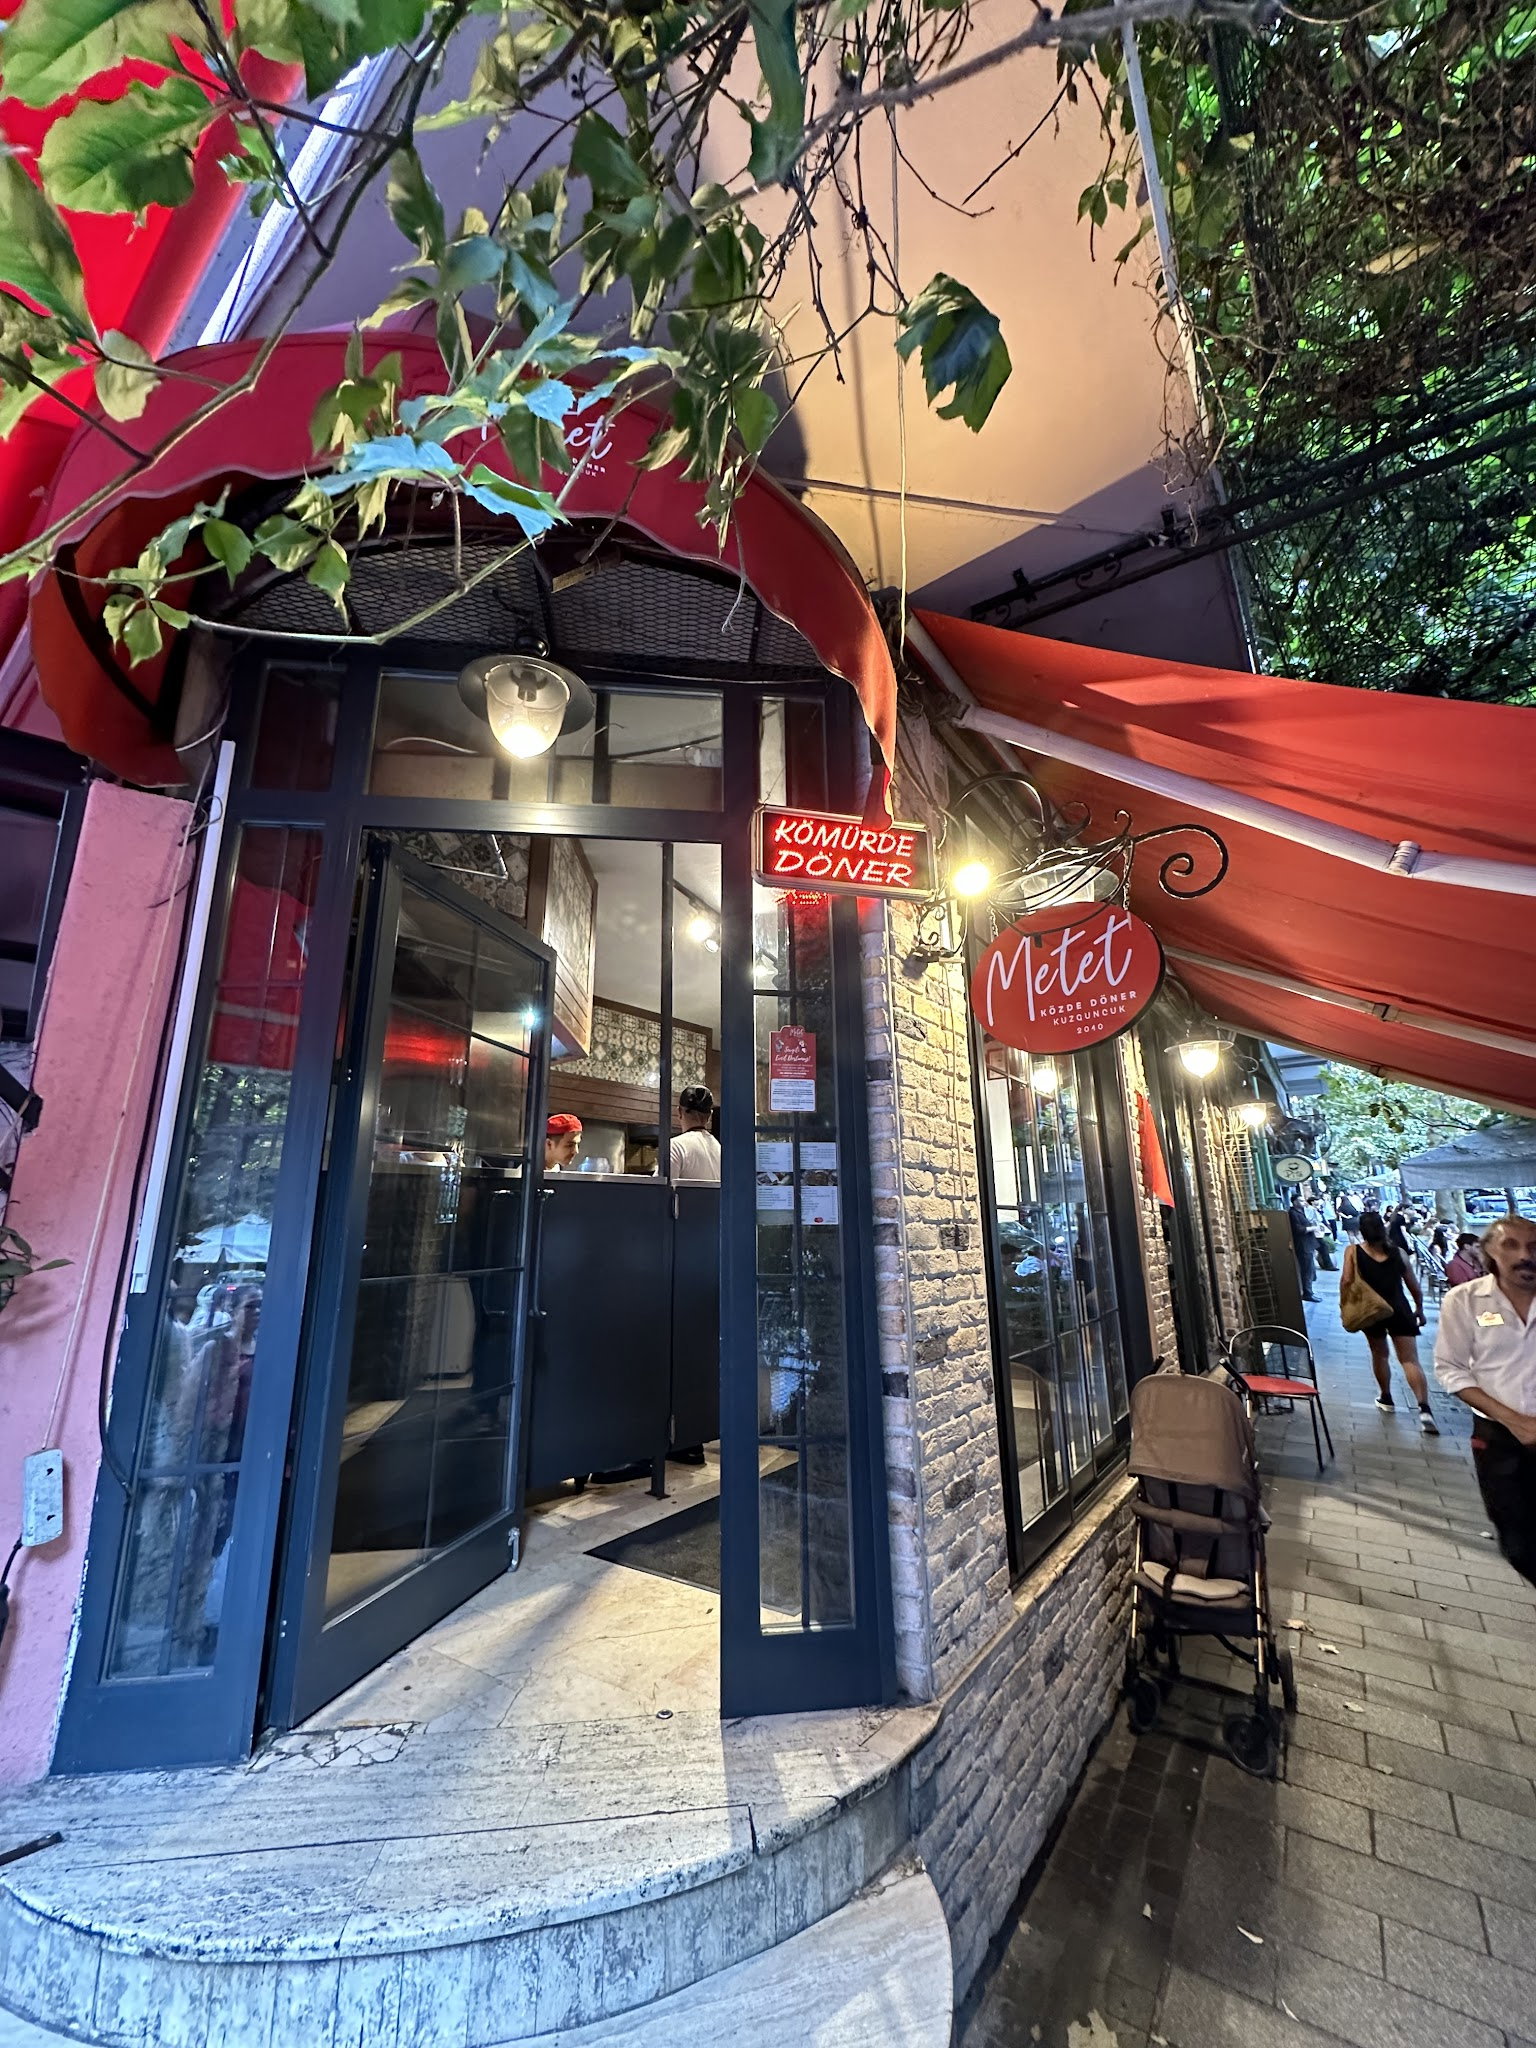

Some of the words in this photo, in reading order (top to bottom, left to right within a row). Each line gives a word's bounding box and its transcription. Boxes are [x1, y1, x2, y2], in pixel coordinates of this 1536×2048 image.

[572, 457, 606, 474] DNER
[774, 819, 915, 857] KÖMÜRDE
[774, 850, 913, 887] DÖNER
[986, 914, 1132, 1027] Metet
[1040, 1001, 1082, 1018] KÖZDE
[1090, 991, 1136, 1007] DÖNER
[1053, 1005, 1126, 1026] KUZGUNCUK
